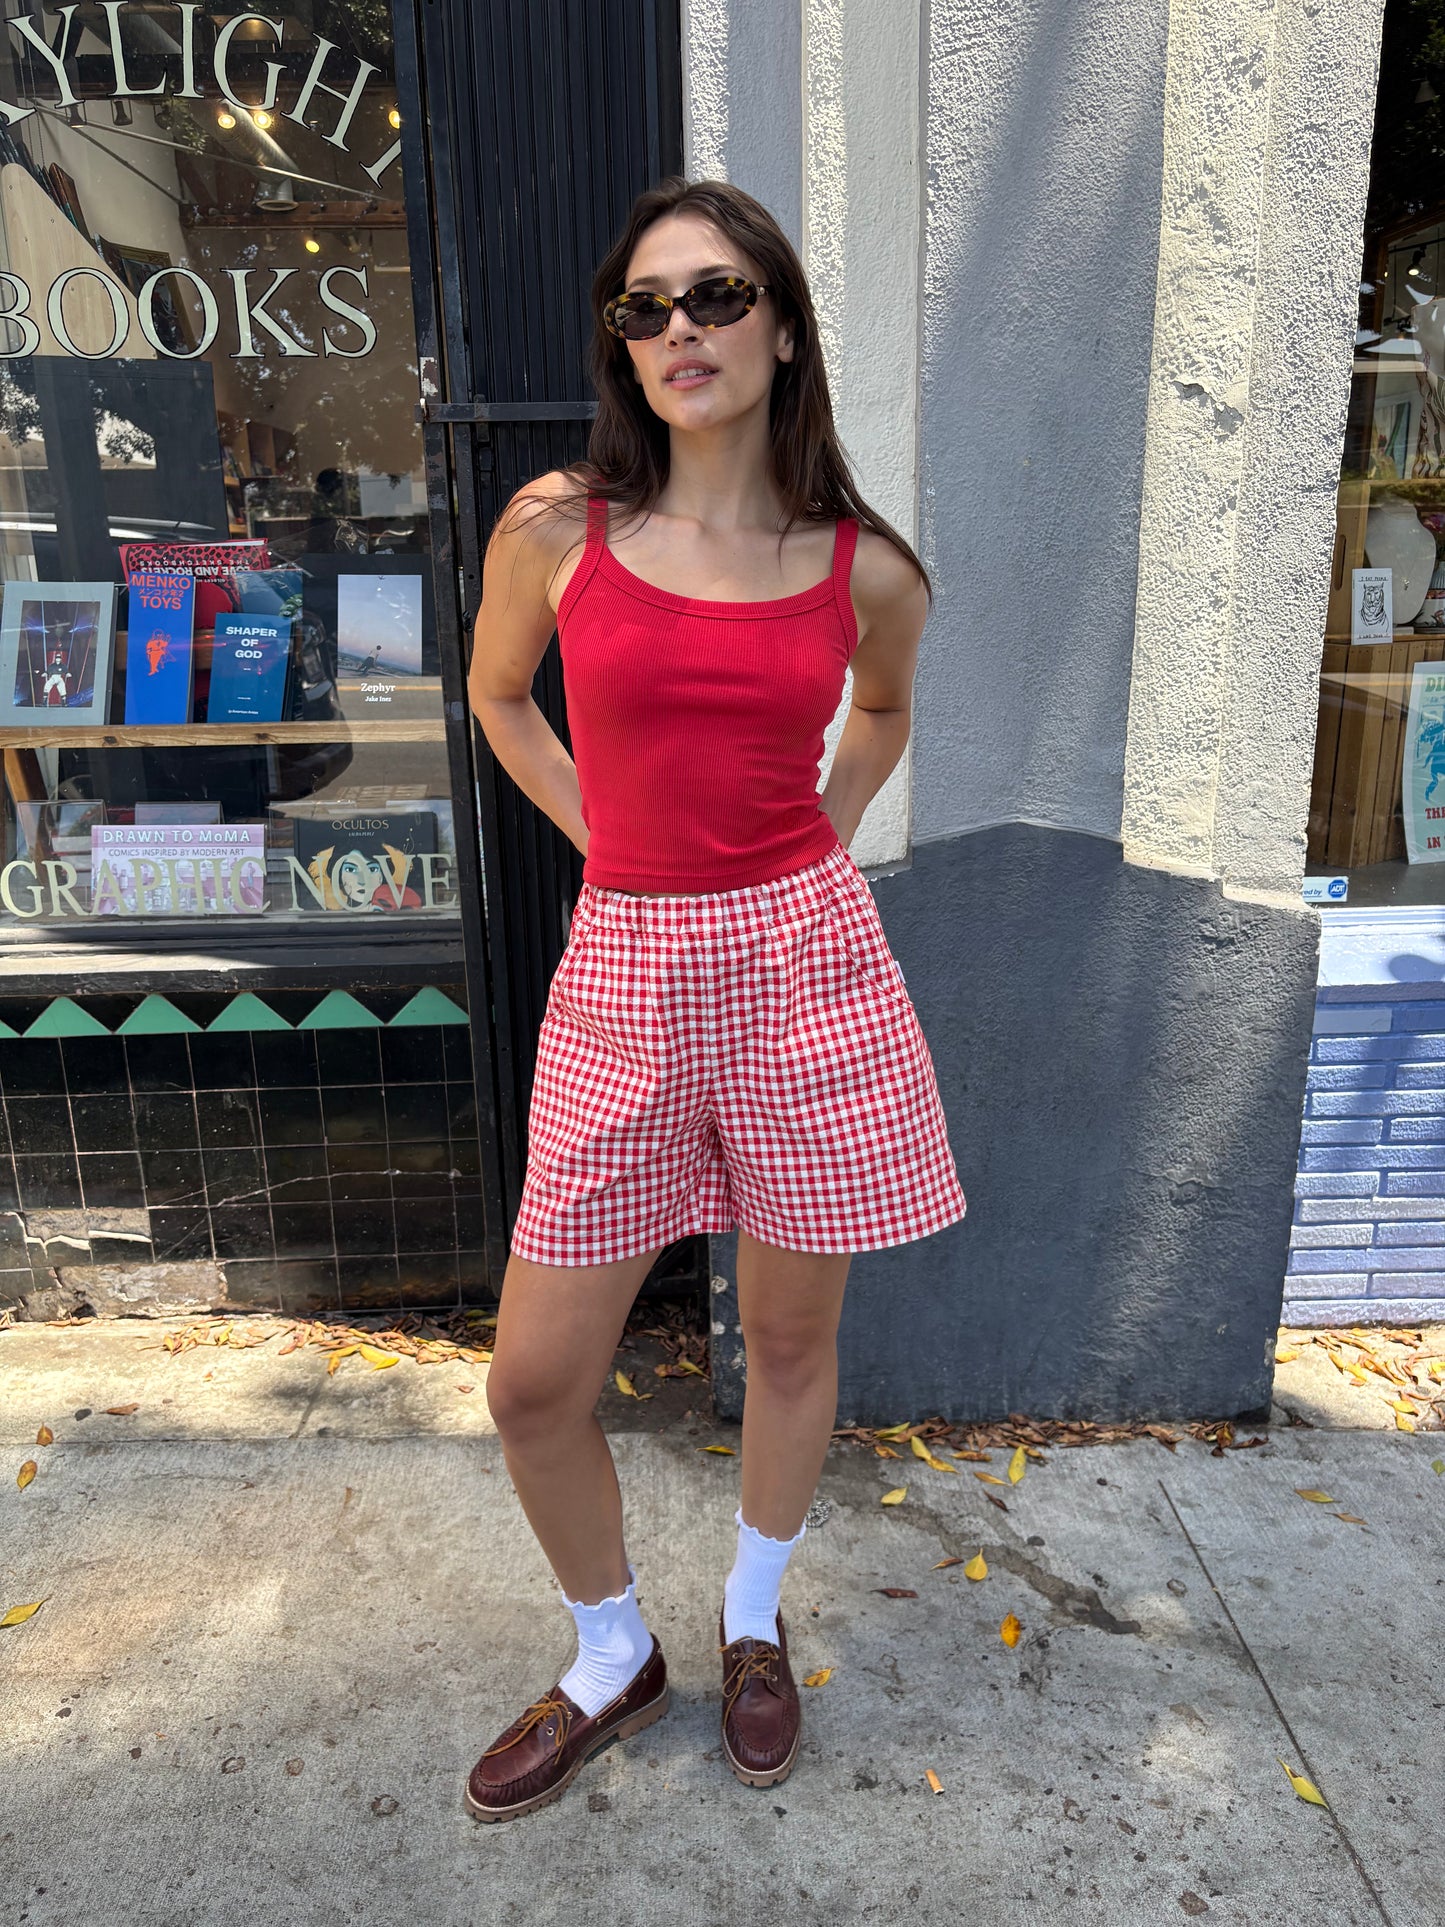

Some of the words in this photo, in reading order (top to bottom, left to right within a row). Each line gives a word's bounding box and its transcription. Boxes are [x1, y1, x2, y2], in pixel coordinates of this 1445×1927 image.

[0, 1, 401, 189] YLIGH
[0, 266, 377, 360] BOOKS
[141, 567, 193, 576] ROCKETS
[194, 566, 219, 576] AND
[132, 574, 191, 590] MENKO
[140, 596, 181, 610] TOYS
[226, 626, 278, 638] SHAPER
[241, 638, 259, 647] OF
[235, 649, 263, 659] GOD
[360, 682, 396, 694] Zephyr
[331, 819, 389, 831] OCULTOS
[103, 829, 165, 843] DRAWN
[171, 829, 193, 843] TO
[200, 829, 250, 842] MoMA
[1427, 836, 1441, 849] IN
[108, 848, 140, 857] COMICS
[142, 848, 178, 857] INSPIRED
[180, 848, 190, 857] BY
[192, 848, 228, 856] MODERN
[229, 848, 245, 856] ART
[0, 855, 271, 917] GRAPHIC
[284, 853, 457, 912] NOVE
[1330, 884, 1345, 893] ADT
